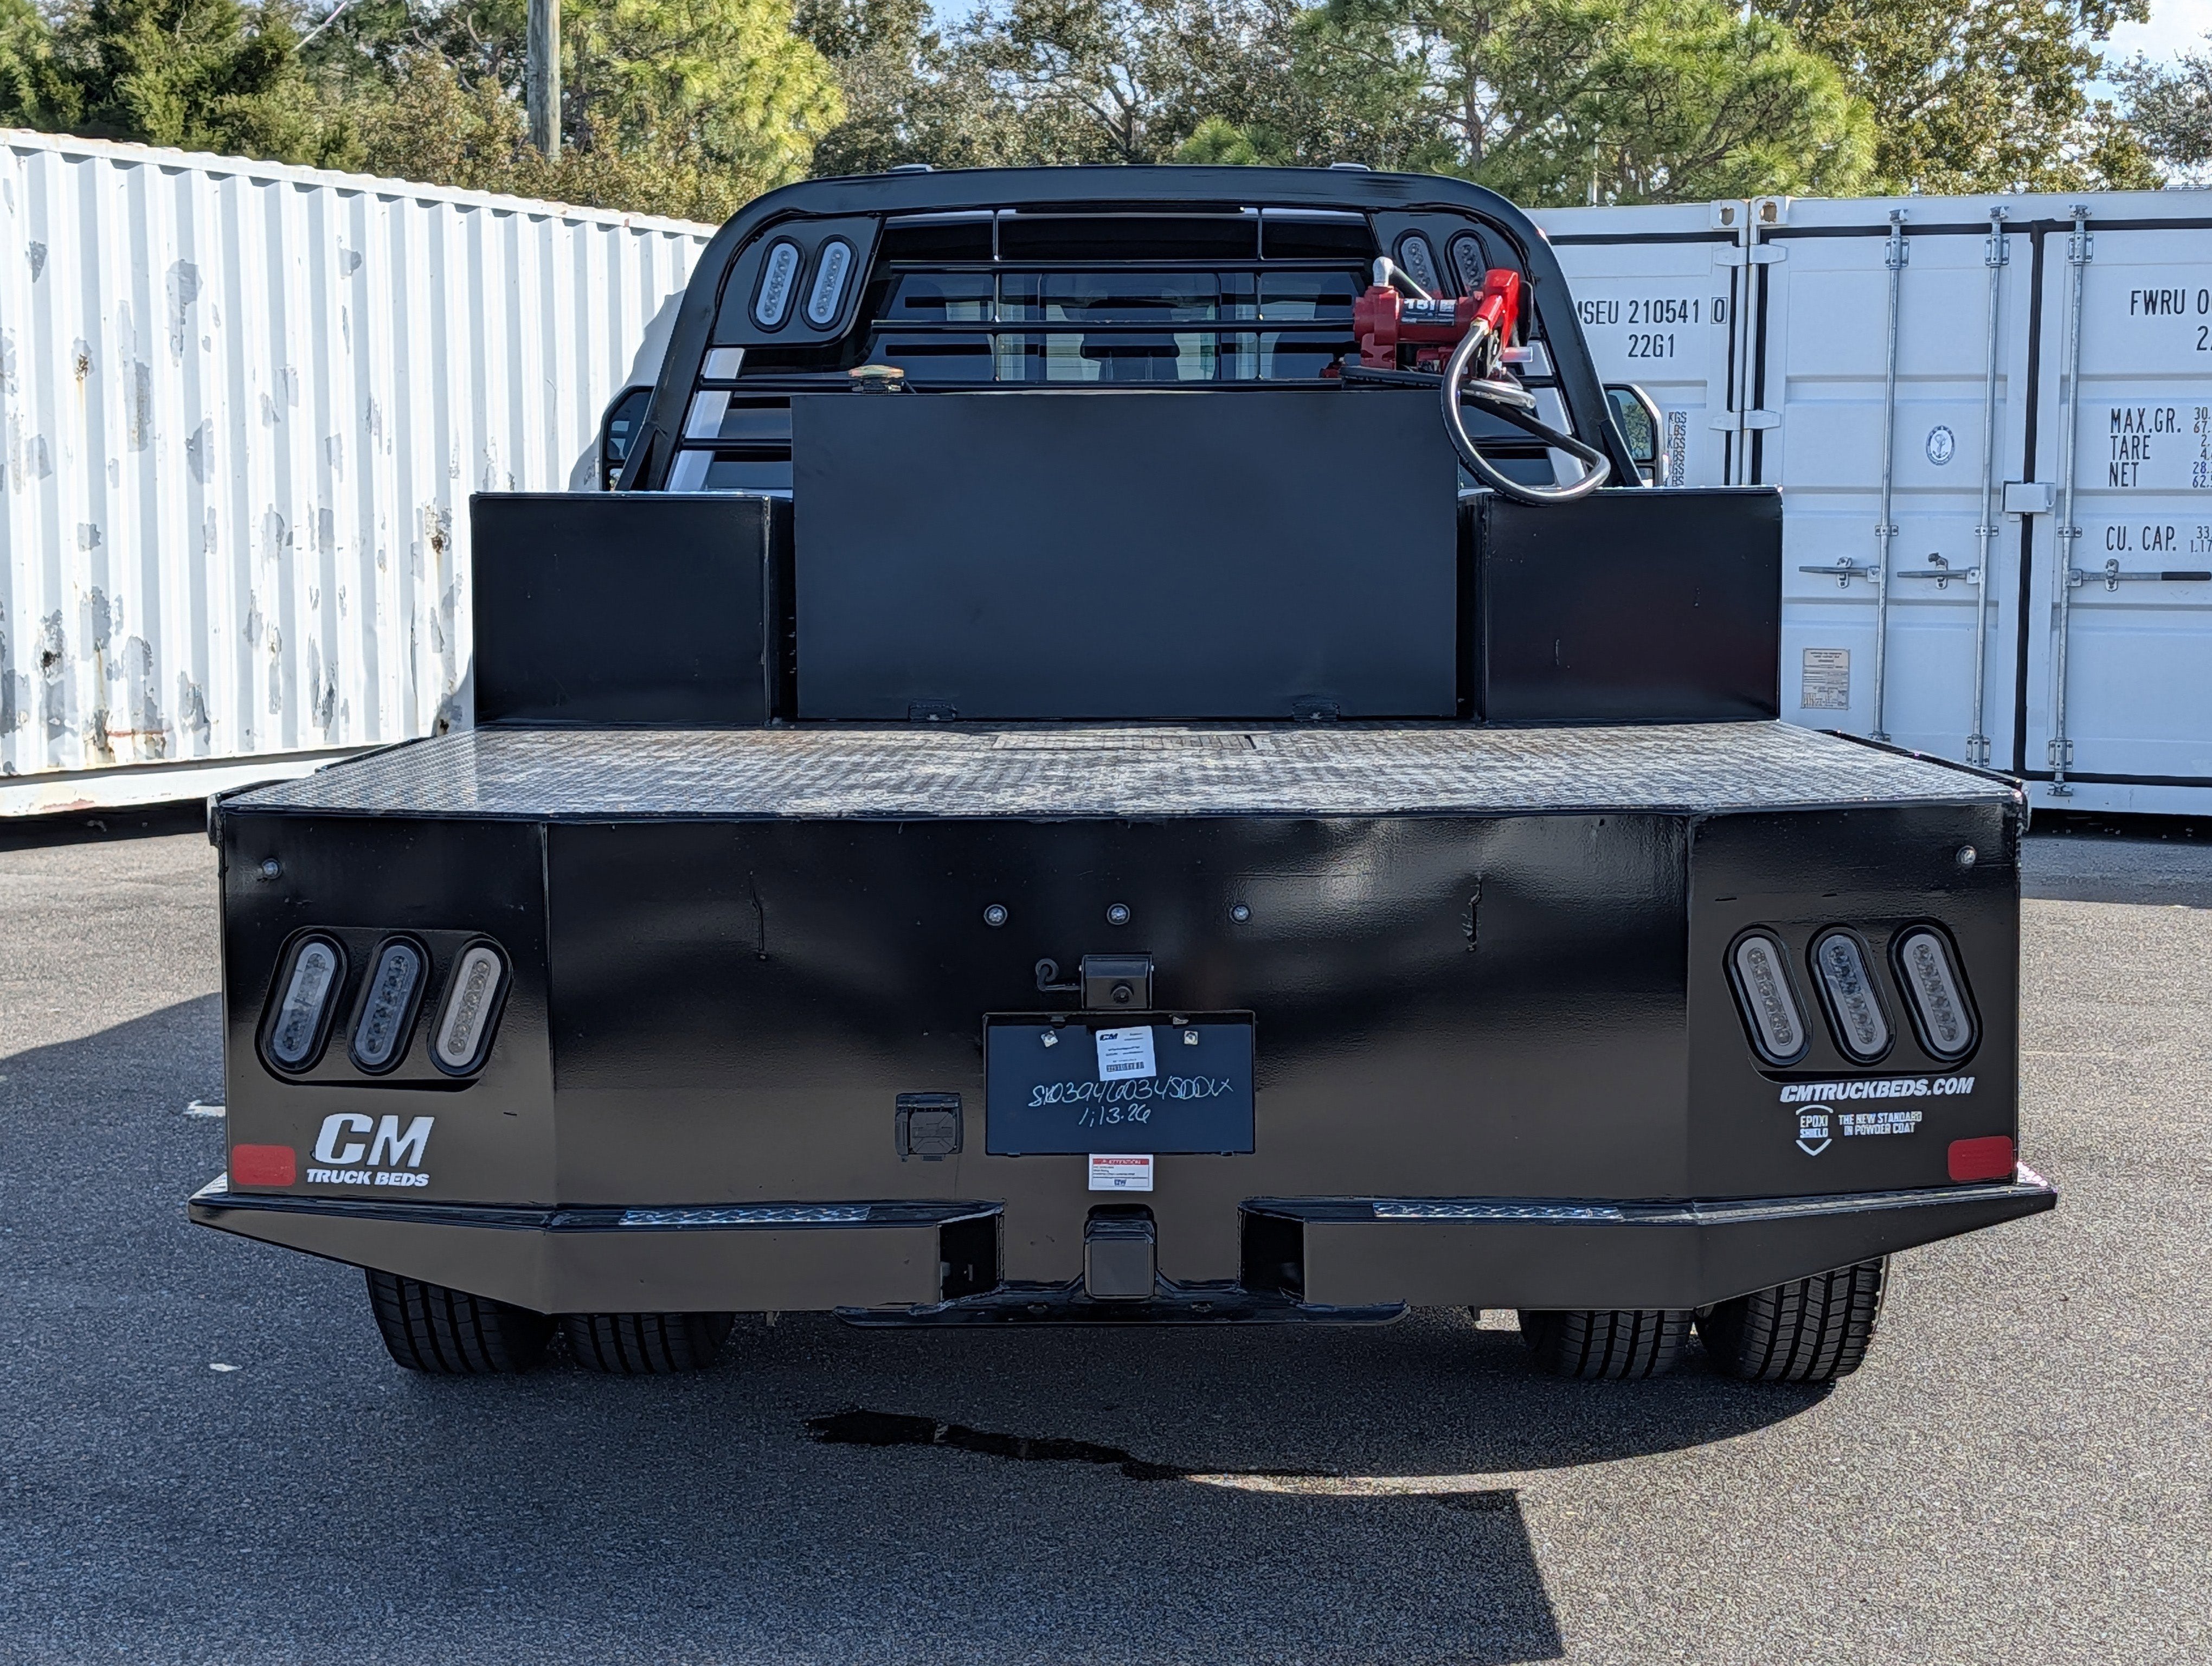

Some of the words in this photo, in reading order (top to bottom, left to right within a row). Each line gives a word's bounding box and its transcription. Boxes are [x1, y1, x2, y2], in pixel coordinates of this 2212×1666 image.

[1628, 299, 1699, 324] 210541
[1714, 299, 1725, 323] 0
[2131, 289, 2186, 316] FWRU
[2197, 289, 2212, 315] 0
[1628, 333, 1674, 358] 22G1
[2196, 325, 2212, 351] 2
[1668, 411, 1687, 424] KGS
[2110, 408, 2181, 433] MAX.GR.
[2110, 435, 2151, 460] TARE
[2109, 462, 2139, 487] NET
[2106, 526, 2132, 551] CU.
[2142, 526, 2176, 551] CAP.
[1780, 1078, 1975, 1102] CMTRUCKBEDS.COM
[1838, 1114, 1854, 1125] THE
[1856, 1113, 1876, 1125] NEW
[1877, 1111, 1922, 1123] STANDARD
[1844, 1125, 1853, 1136] IN
[1855, 1124, 1891, 1136] POWDER
[1893, 1122, 1915, 1133] COAT
[315, 1113, 434, 1167] CM
[307, 1168, 372, 1185] TRUCK
[374, 1171, 429, 1187] BEDS
